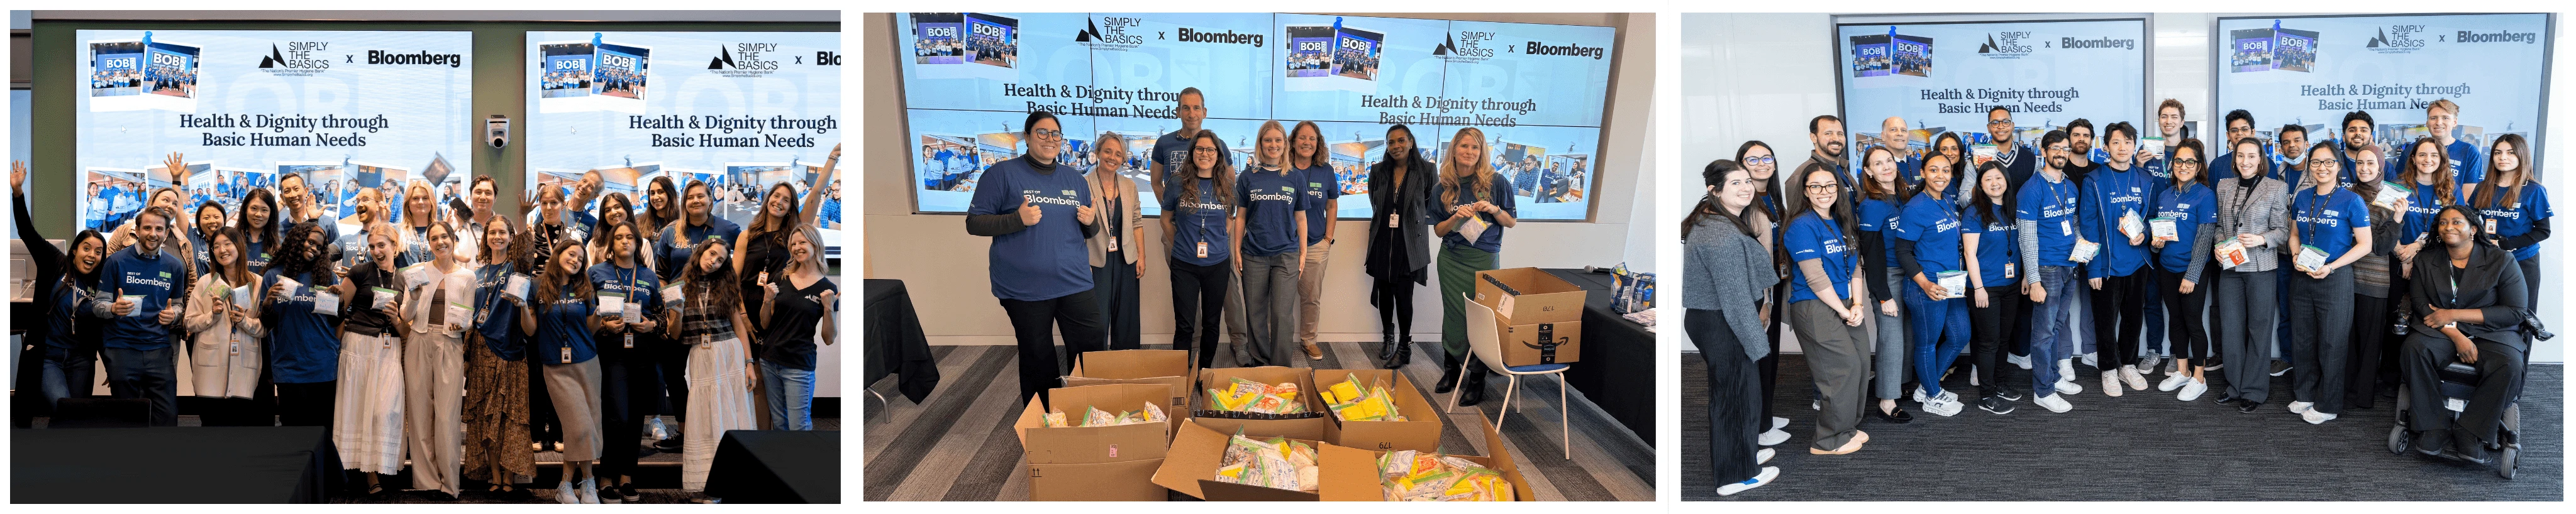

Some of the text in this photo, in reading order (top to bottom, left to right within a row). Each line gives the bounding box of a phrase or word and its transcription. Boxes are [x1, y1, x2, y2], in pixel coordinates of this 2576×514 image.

[1104, 17, 1141, 27] SIMPLY
[928, 28, 951, 36] BOB
[974, 23, 999, 36] BOB
[1104, 26, 1124, 35] THE
[2392, 25, 2425, 33] SIMPLY
[1105, 35, 1143, 45] BASICS
[1178, 28, 1263, 48] Bloomberg
[1462, 31, 1495, 41] SIMPLY
[2001, 31, 2031, 40] SIMPLY
[2392, 32, 2409, 40] THE
[2457, 30, 2536, 44] Bloomberg
[289, 41, 328, 51] SIMPLY
[738, 43, 777, 52] SIMPLY
[1342, 38, 1365, 50] BOB
[1460, 40, 1479, 48] THE
[2062, 36, 2135, 50] Bloomberg
[2281, 37, 2302, 47] BOB
[2391, 40, 2424, 48] BASICS
[1460, 48, 1494, 57] BASICS
[1526, 41, 1603, 60] Bloomberg
[1898, 43, 1918, 53] BOB
[2001, 45, 2033, 53] BASICS
[153, 53, 179, 66] BOB
[289, 51, 310, 59] THE
[368, 50, 460, 67] Bloomberg
[603, 54, 630, 67] BOB
[738, 52, 759, 60] THE
[106, 58, 130, 68] BOB
[289, 60, 329, 69] BASICS
[557, 60, 579, 70] BOB
[738, 61, 778, 70] BASICS
[1004, 83, 1179, 104] Health & Dignity throu
[1921, 87, 2080, 102] Health & Dignity through
[2301, 82, 2471, 99] Health & Dignity through
[1026, 101, 1177, 119] Basic Human Needs
[1361, 94, 1536, 115] Health & Dignity through
[1938, 101, 2062, 114] Basic Huan Needs
[2318, 99, 2353, 110] Basic
[2357, 99, 2406, 110] Human
[180, 113, 389, 133] Health & Dignity through
[629, 114, 837, 134] Health & Dignity through
[1379, 111, 1516, 128] Basic Human Needs
[203, 132, 366, 146] Basic Human Needs
[652, 133, 814, 147] Basic Human Needs
[1024, 195, 1080, 209] Bloomberg
[1250, 192, 1293, 204] Bloomberg
[126, 276, 171, 290] Bloomberg
